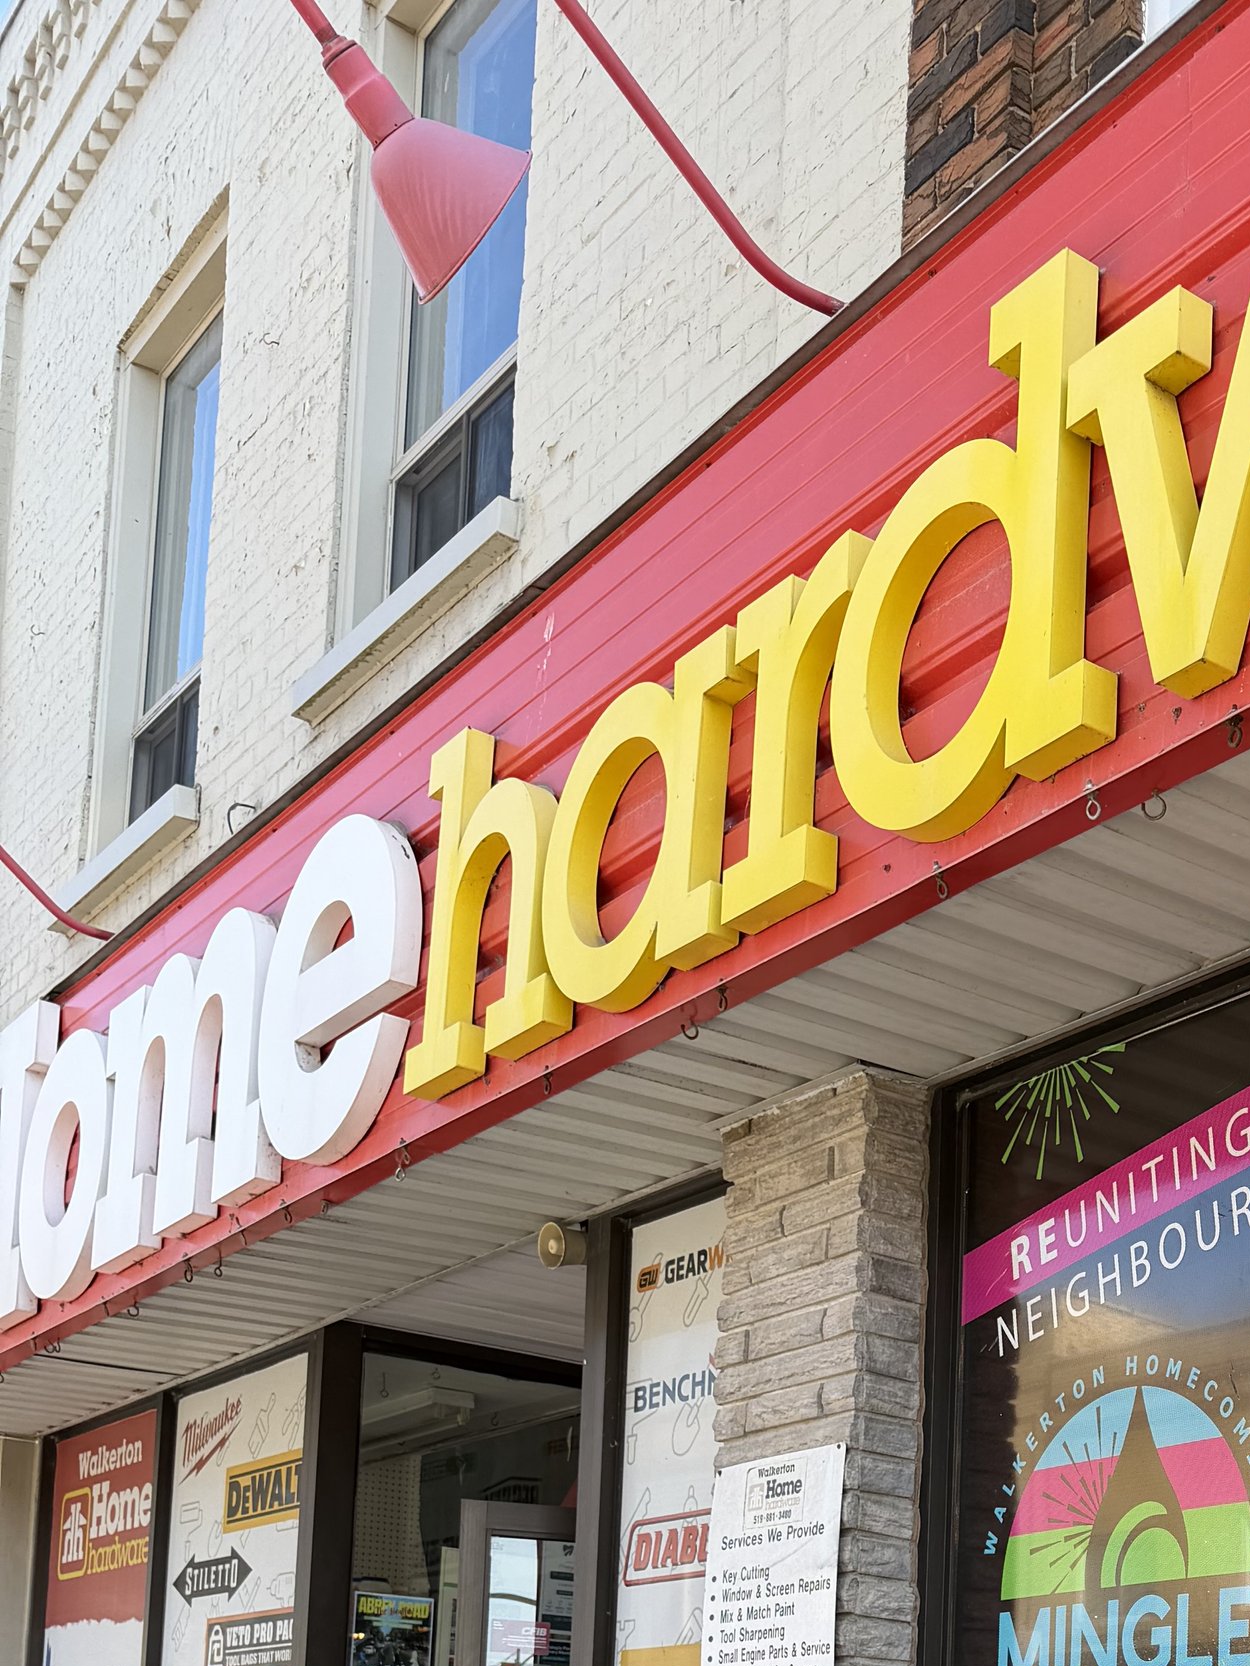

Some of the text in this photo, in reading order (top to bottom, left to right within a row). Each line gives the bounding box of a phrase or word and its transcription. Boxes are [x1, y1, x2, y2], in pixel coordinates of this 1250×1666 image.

[0, 812, 423, 1326] ome
[664, 1244, 724, 1285] GEARW
[182, 1395, 243, 1470] Milwaukee
[79, 1438, 142, 1480] Walkerton
[758, 1463, 796, 1479] Walkerton
[984, 1365, 1105, 1556] WALKERTON
[765, 1478, 803, 1499] Home
[89, 1481, 153, 1540] Home
[721, 1521, 825, 1550] Services We Provide
[87, 1535, 149, 1575] hardware
[185, 1558, 239, 1596] STILETTO
[722, 1564, 770, 1585] Key Cutting
[721, 1575, 831, 1603] Window & Screen Repairs
[720, 1602, 795, 1624] Mix & Match Paint
[226, 1624, 251, 1648] VETO
[253, 1621, 275, 1646] PRO
[720, 1624, 785, 1644] Tool Sharpening
[241, 1652, 258, 1666] BAGS
[258, 1650, 273, 1665] THAT
[718, 1640, 831, 1665] Small Engine Parts & Service
